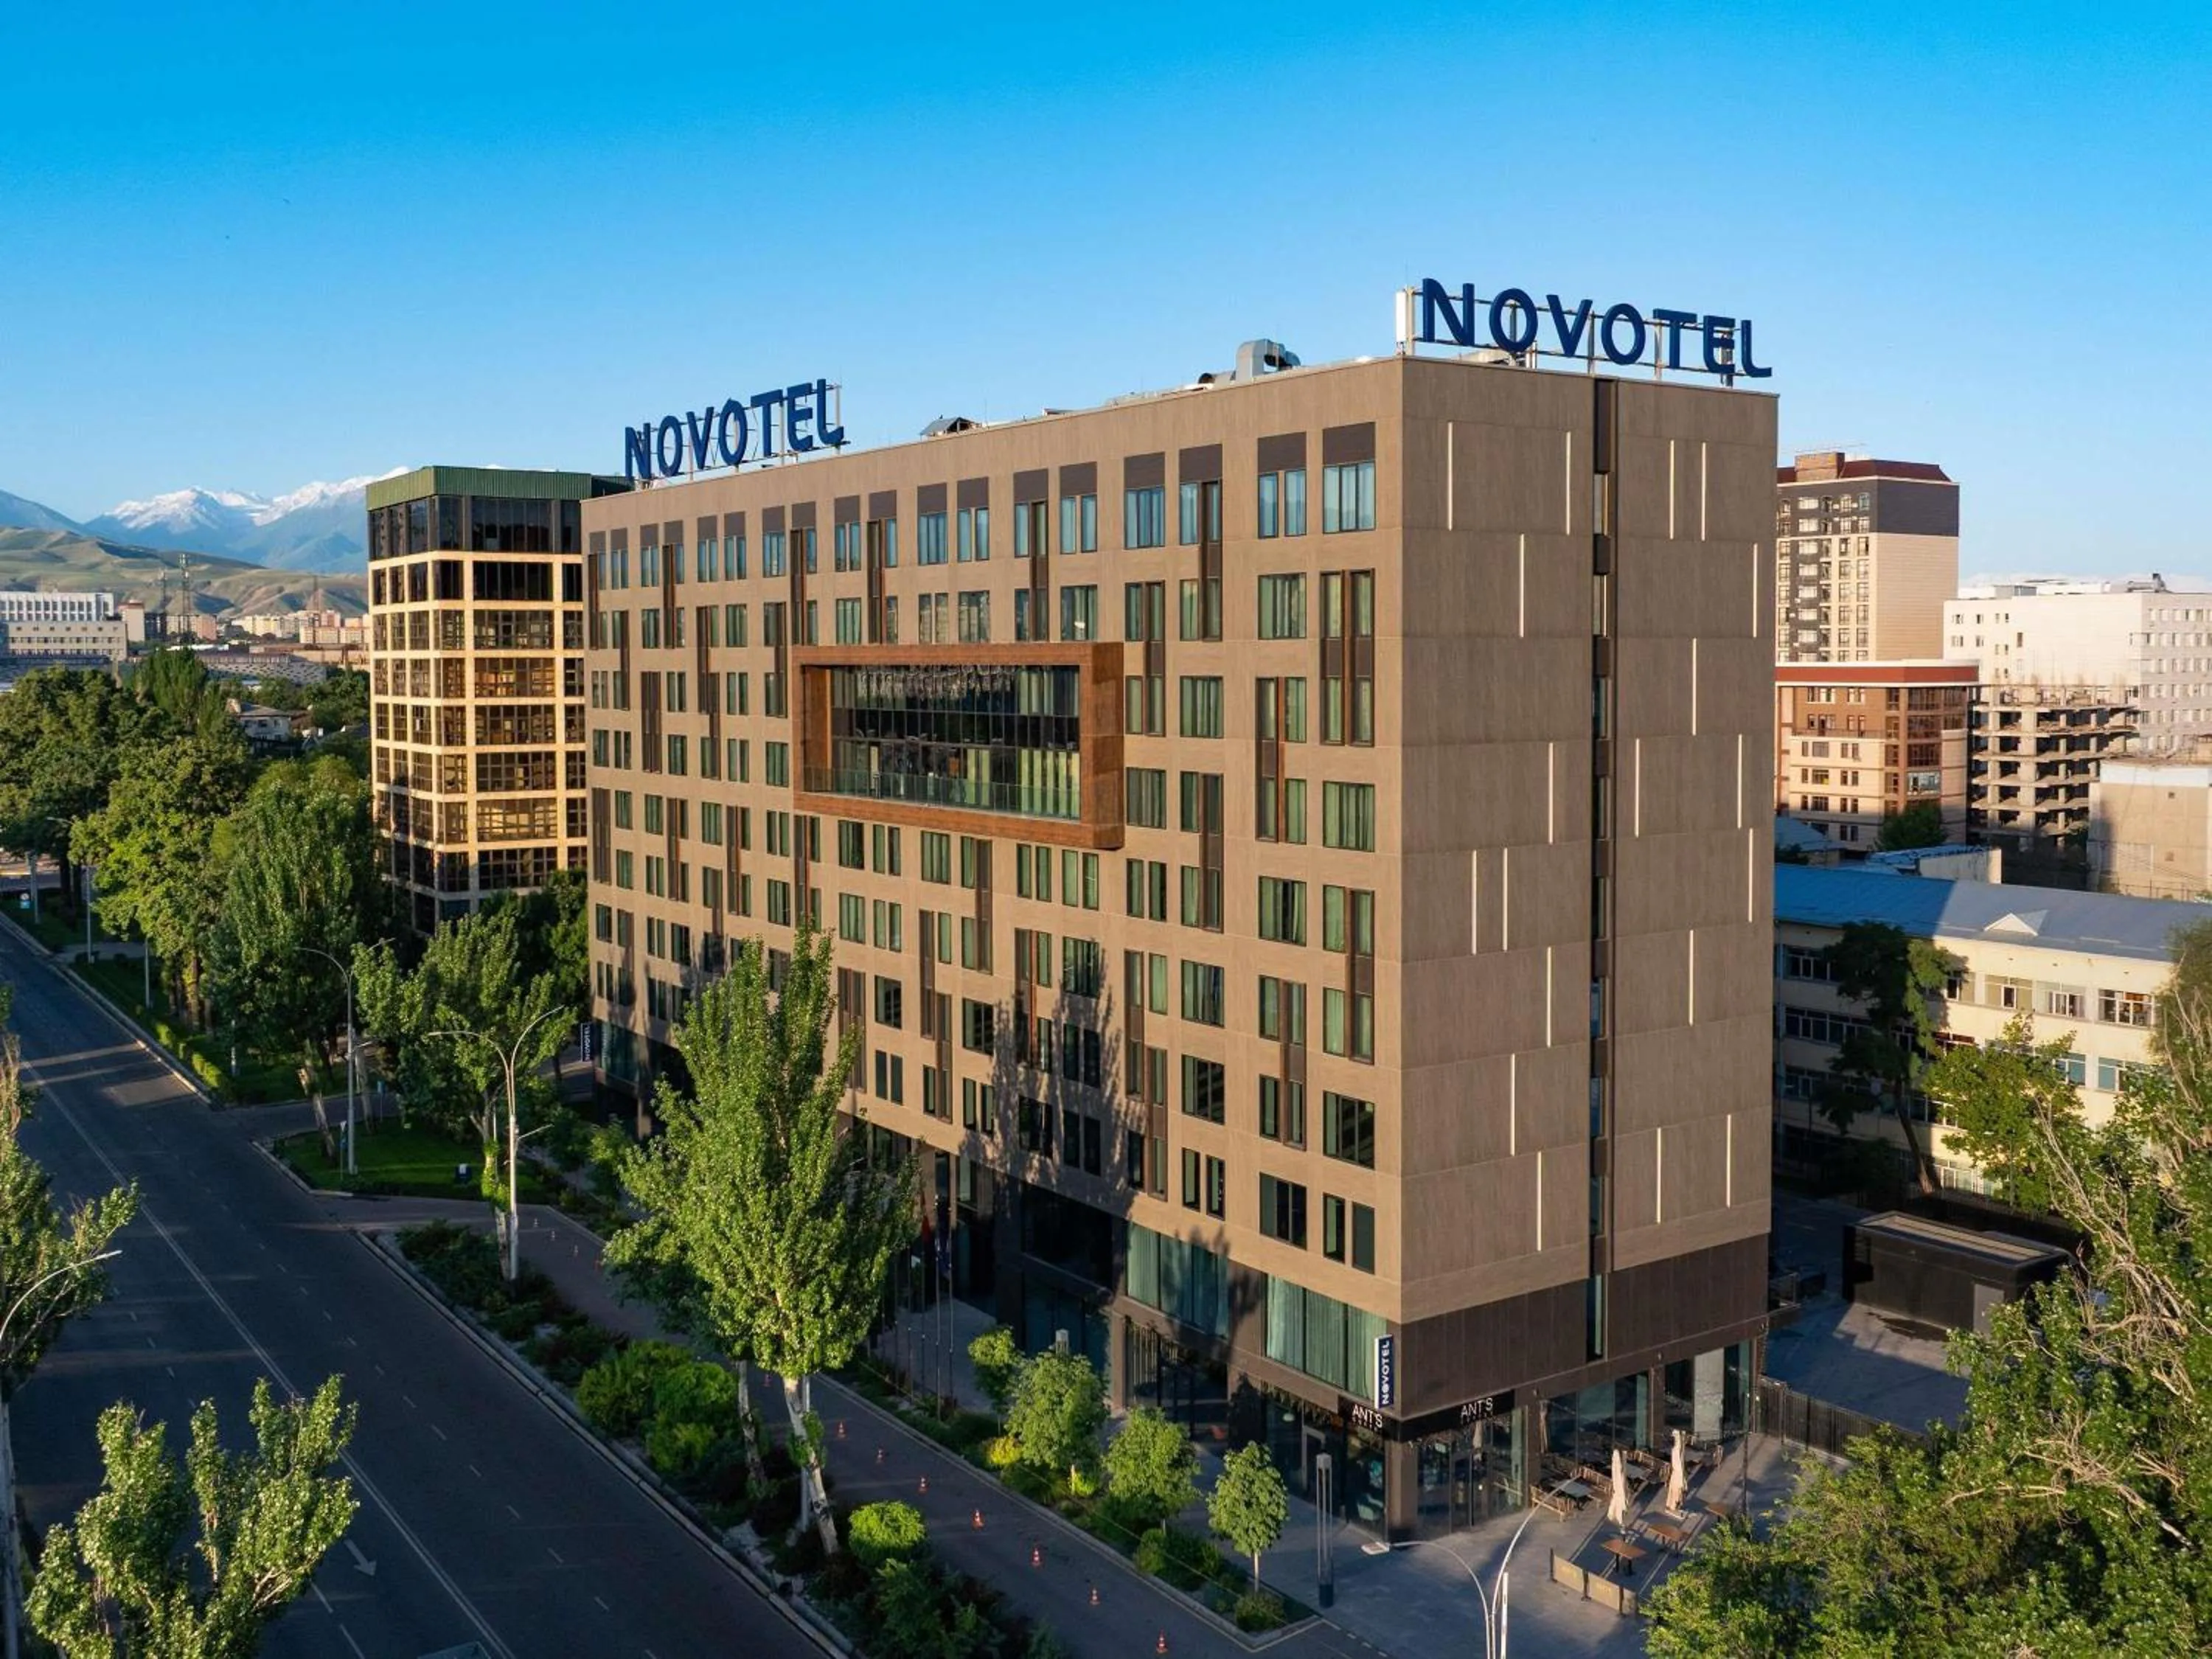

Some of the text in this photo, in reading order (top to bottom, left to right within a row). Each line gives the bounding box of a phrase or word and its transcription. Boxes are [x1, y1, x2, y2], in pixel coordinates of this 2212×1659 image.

[1422, 278, 1772, 378] NOVOTEL
[625, 378, 844, 480] NOVOTEL
[1381, 1340, 1390, 1405] NOVOTEL
